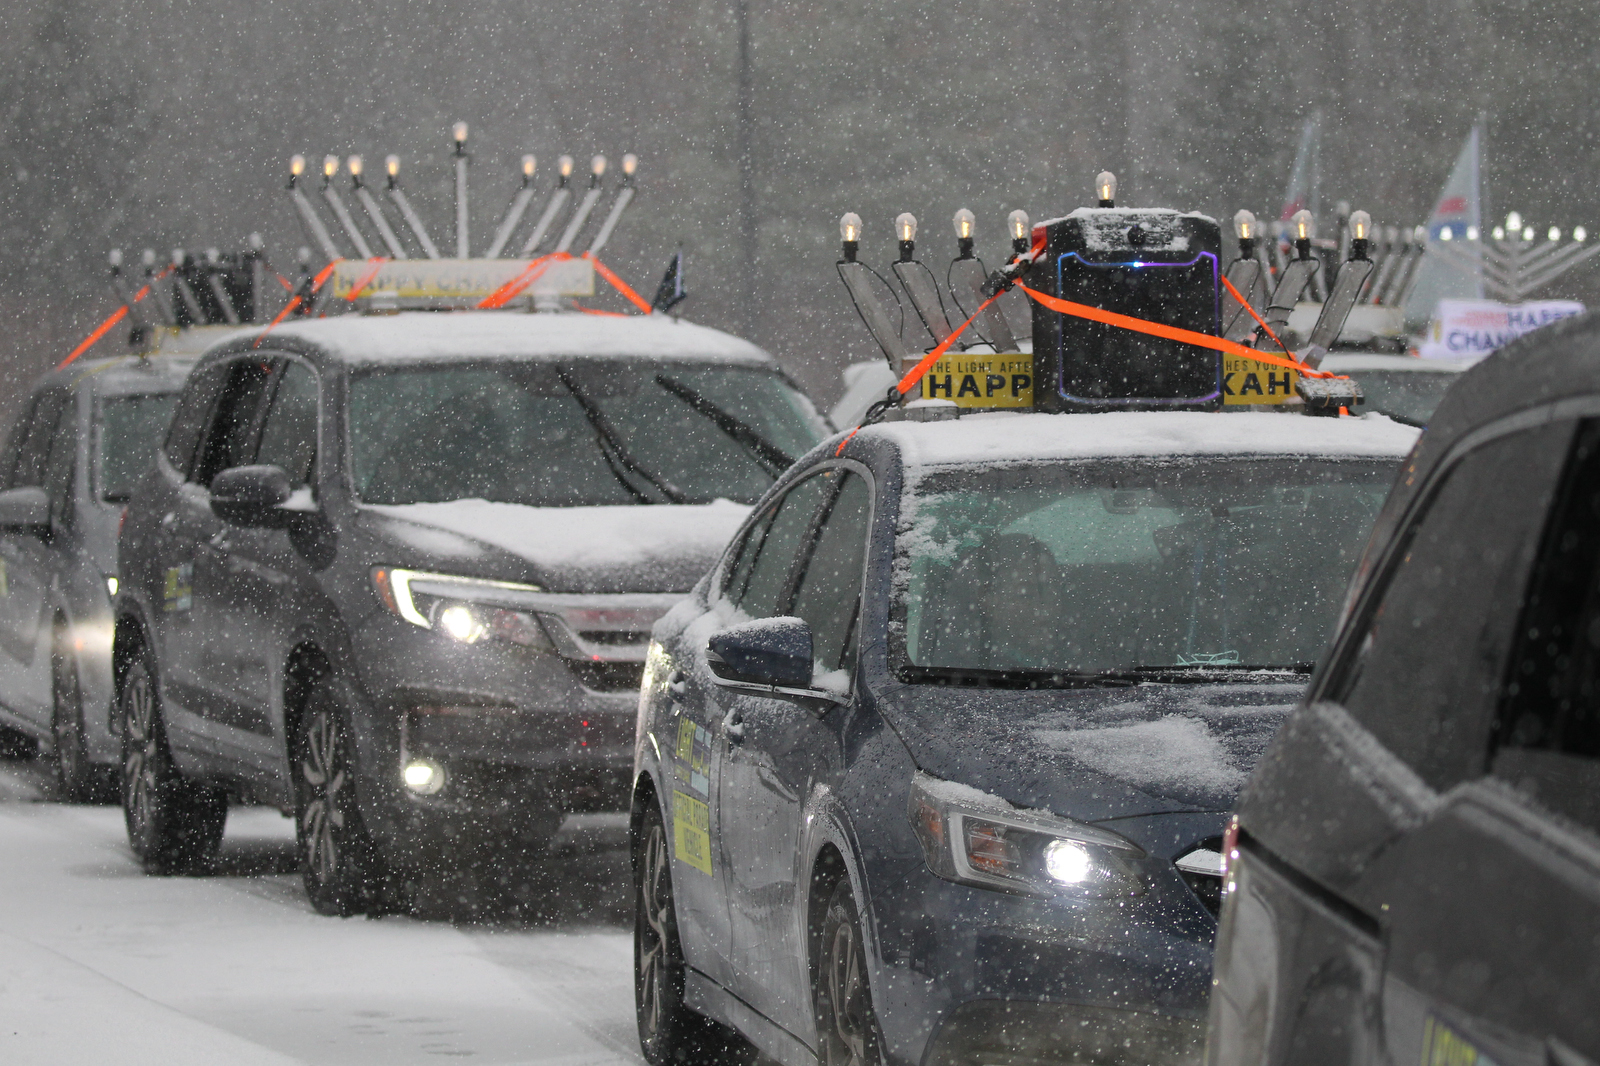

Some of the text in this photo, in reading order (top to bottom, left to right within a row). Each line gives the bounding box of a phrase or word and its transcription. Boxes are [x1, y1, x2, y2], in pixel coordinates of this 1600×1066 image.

[957, 361, 993, 373] LIGHT
[929, 374, 1032, 398] HAPP
[1223, 372, 1290, 396] KAH
